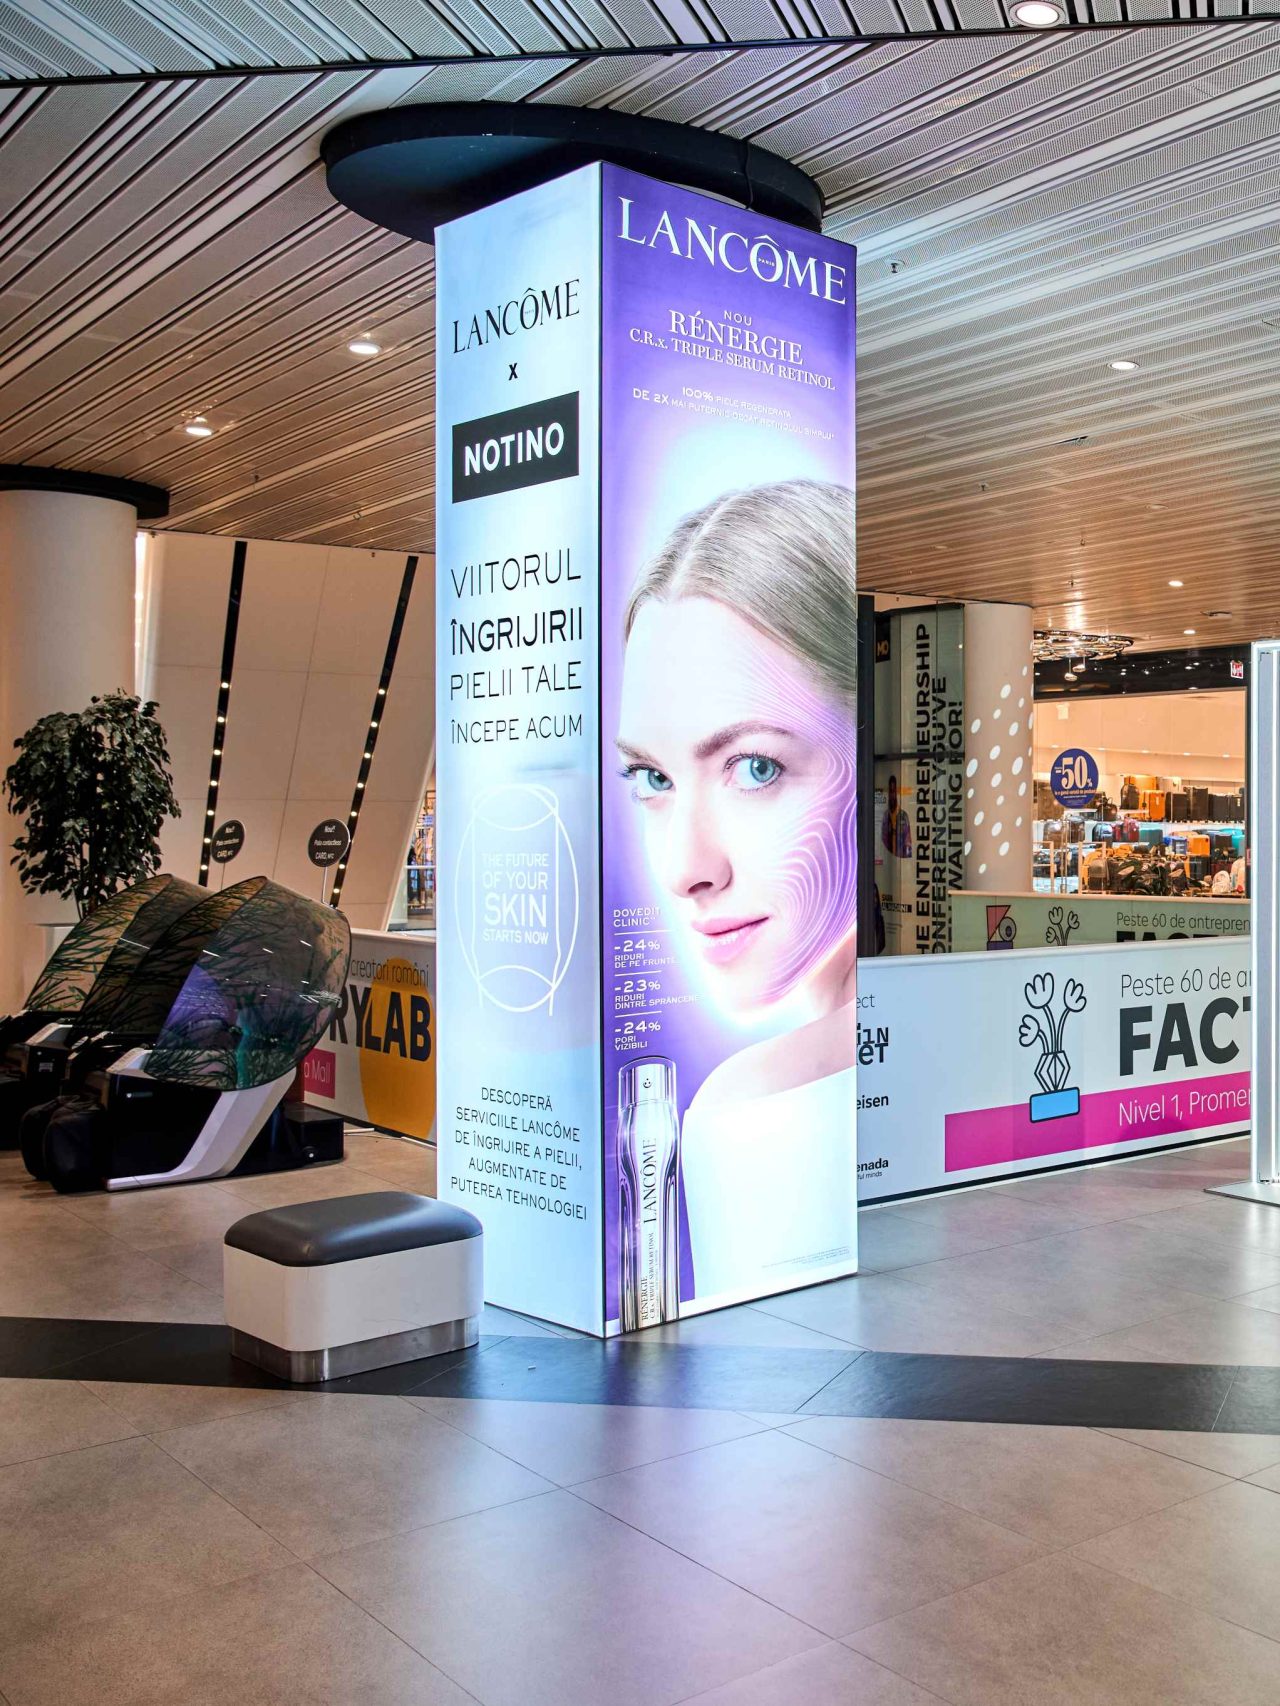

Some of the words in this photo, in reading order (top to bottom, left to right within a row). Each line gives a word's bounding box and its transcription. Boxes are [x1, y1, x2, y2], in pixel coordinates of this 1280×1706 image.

[617, 196, 847, 305] LANCÔME
[453, 279, 580, 354] LANCÔME
[724, 310, 752, 326] NOU
[668, 309, 803, 366] RÉNERGIE
[671, 337, 723, 363] TRIPLE
[726, 352, 775, 376] SERUM
[778, 365, 836, 390] RETINOL
[633, 388, 650, 401] DE
[654, 393, 669, 405] 2X
[682, 386, 713, 401] 100%
[463, 421, 565, 476] NOTINO
[451, 548, 582, 598] VIITORUL
[450, 606, 583, 656] ÎNGRIJIRII
[451, 668, 512, 700] PIELII
[521, 661, 582, 694] TALE
[451, 718, 519, 745] ÎNCEPE
[526, 713, 583, 740] ACUM
[916, 623, 931, 917] ENTREPRENEURSHIP
[482, 853, 503, 866] THE
[506, 852, 549, 867] FUTURE
[482, 871, 502, 889] OF
[505, 871, 549, 890] YOUR
[484, 892, 547, 928] SKIN
[613, 907, 661, 918] DOVEDIT
[1116, 912, 1149, 927] Peste
[1152, 913, 1167, 928] 60
[1170, 913, 1185, 929] de
[482, 929, 522, 944] STARTS
[524, 931, 549, 945] NOW
[614, 938, 661, 953] -24%
[614, 953, 645, 962] RIDURI
[614, 961, 627, 969] DE
[629, 959, 641, 968] PE
[351, 958, 389, 981] creatori
[391, 961, 429, 988] români
[614, 979, 661, 993] -23%
[1121, 972, 1175, 998] Peste
[1180, 968, 1203, 993] 60
[1209, 966, 1231, 991] de
[1236, 970, 1251, 988] a
[614, 993, 645, 1003] RIDURI
[614, 1000, 647, 1010] DINTRE
[614, 1020, 661, 1035] -24%
[615, 1035, 637, 1044] PORI
[1119, 996, 1252, 1077] FAC
[614, 1040, 648, 1051] VIZIBILI
[312, 1061, 331, 1084] Mall
[481, 1087, 553, 1111] DESCOPERĂ
[1119, 1095, 1165, 1127] Nivel
[1171, 1093, 1183, 1120] 1,
[456, 1106, 518, 1131] SERVICIILE
[522, 1118, 581, 1143] LANCÔME
[455, 1130, 470, 1146] DE
[473, 1131, 530, 1158] ÎNGRIJIRE
[533, 1146, 542, 1159] A
[545, 1147, 582, 1171] PIELII,
[468, 1156, 547, 1186] AUGMENTATE
[551, 1174, 567, 1190] DE
[640, 1138, 657, 1224] LANCÔME
[865, 1170, 883, 1179] minds
[451, 1176, 503, 1201] PUTEREA
[506, 1188, 587, 1221] TEHNOLOGIEI
[640, 1275, 649, 1321] RÉNERGIE
